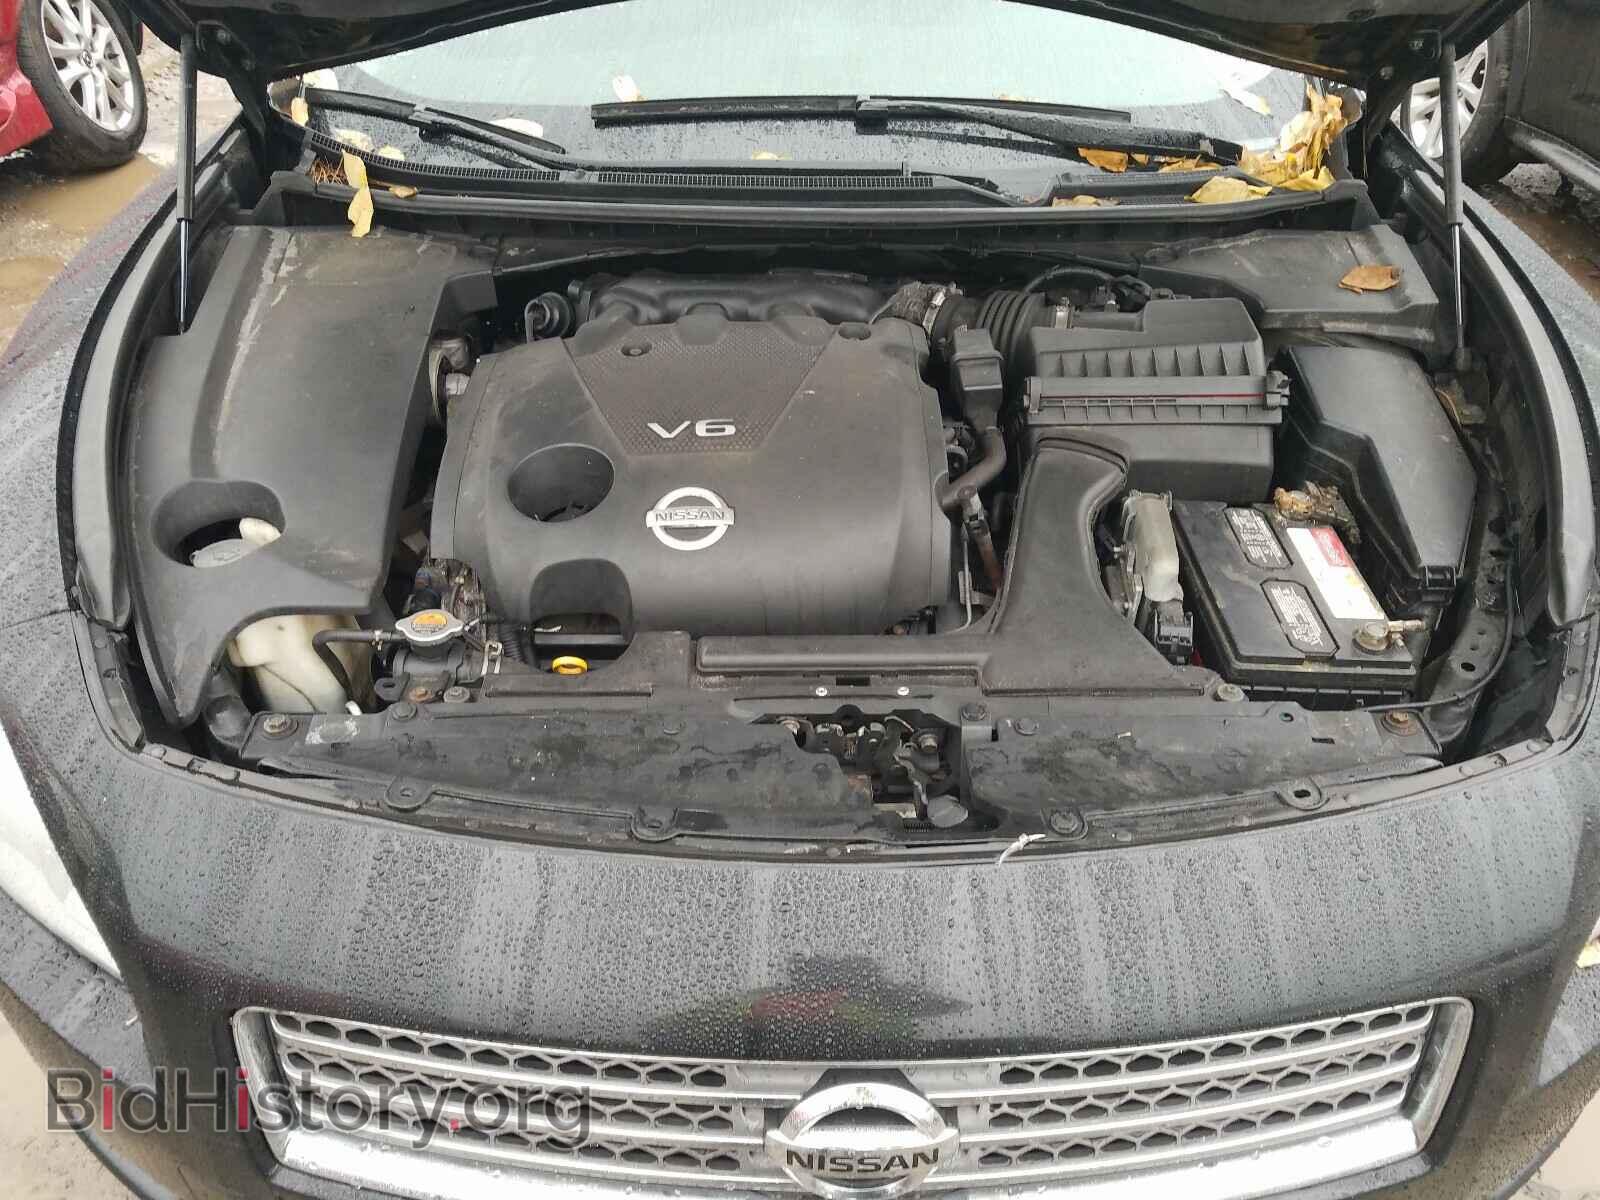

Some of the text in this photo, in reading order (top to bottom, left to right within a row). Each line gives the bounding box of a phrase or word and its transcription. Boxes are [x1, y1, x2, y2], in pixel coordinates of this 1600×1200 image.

[647, 418, 736, 438] V6
[655, 510, 725, 522] NISSAN
[786, 1148, 939, 1173] NISSAN
